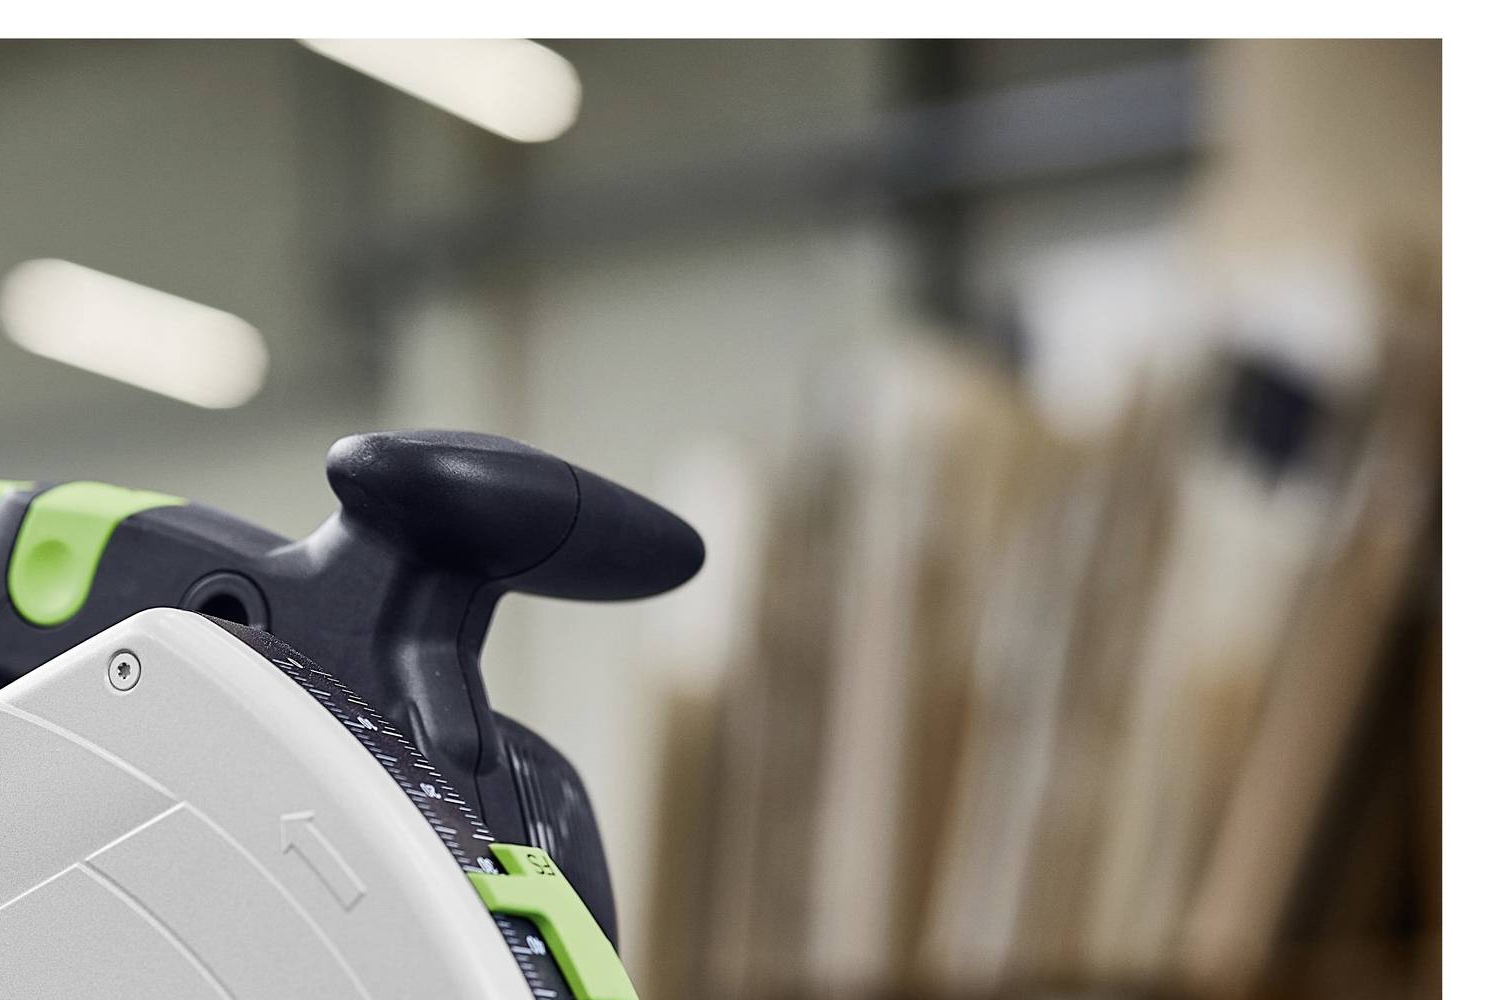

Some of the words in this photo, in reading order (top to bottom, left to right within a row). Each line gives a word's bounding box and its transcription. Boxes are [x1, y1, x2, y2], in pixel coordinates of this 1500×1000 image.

[420, 782, 442, 799] 20
[526, 853, 556, 876] FS
[526, 935, 547, 956] 40
